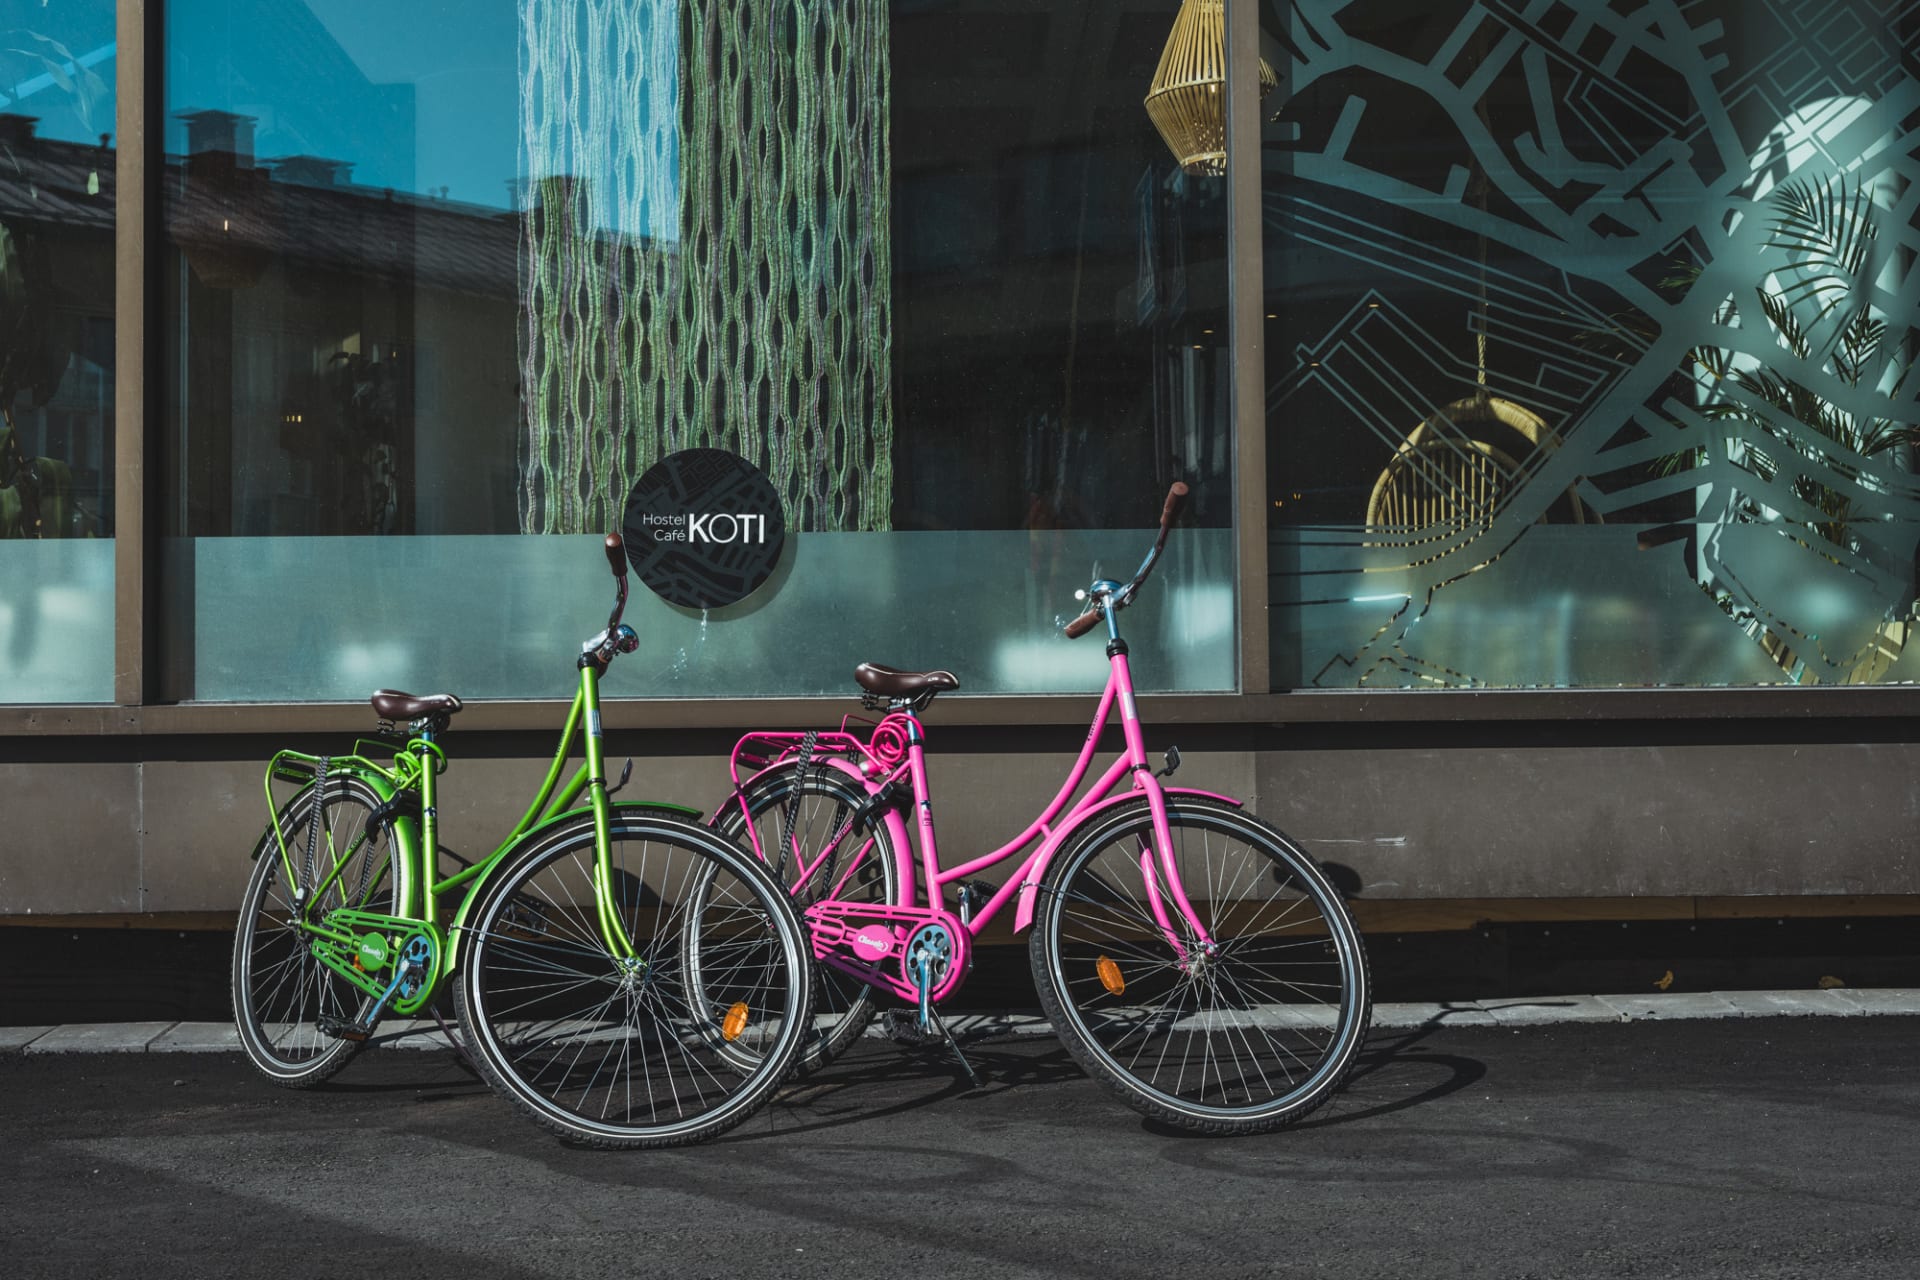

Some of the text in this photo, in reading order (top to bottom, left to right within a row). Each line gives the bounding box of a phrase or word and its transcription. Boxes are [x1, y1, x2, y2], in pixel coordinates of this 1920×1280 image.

[643, 513, 686, 525] Hostel
[688, 513, 765, 543] KOTI
[654, 529, 686, 541] Café
